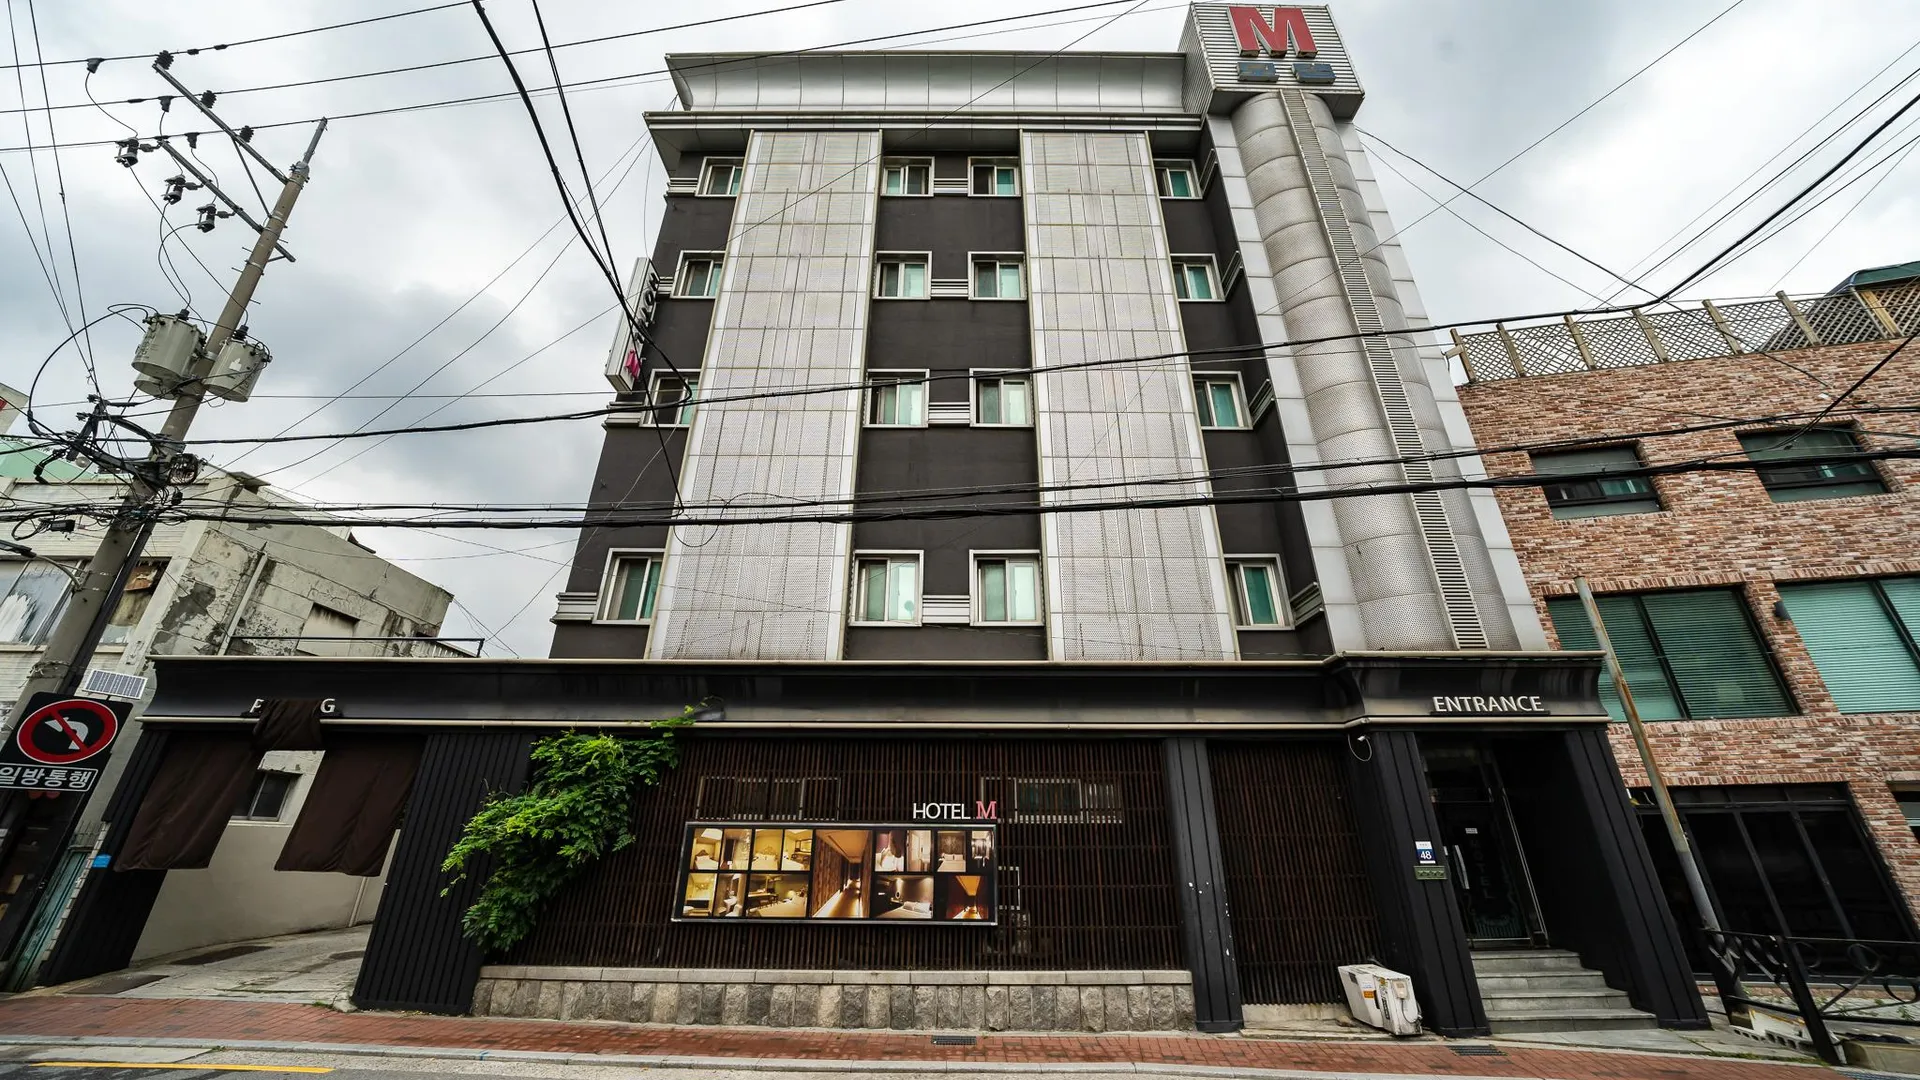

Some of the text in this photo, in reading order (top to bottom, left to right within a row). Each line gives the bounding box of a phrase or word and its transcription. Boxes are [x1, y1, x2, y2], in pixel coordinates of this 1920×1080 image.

[1228, 6, 1318, 57] M
[1432, 696, 1545, 713] ENTRANCE
[0, 766, 92, 788] 일방통행
[913, 800, 997, 820] HOTEL M
[1420, 850, 1432, 860] 48
